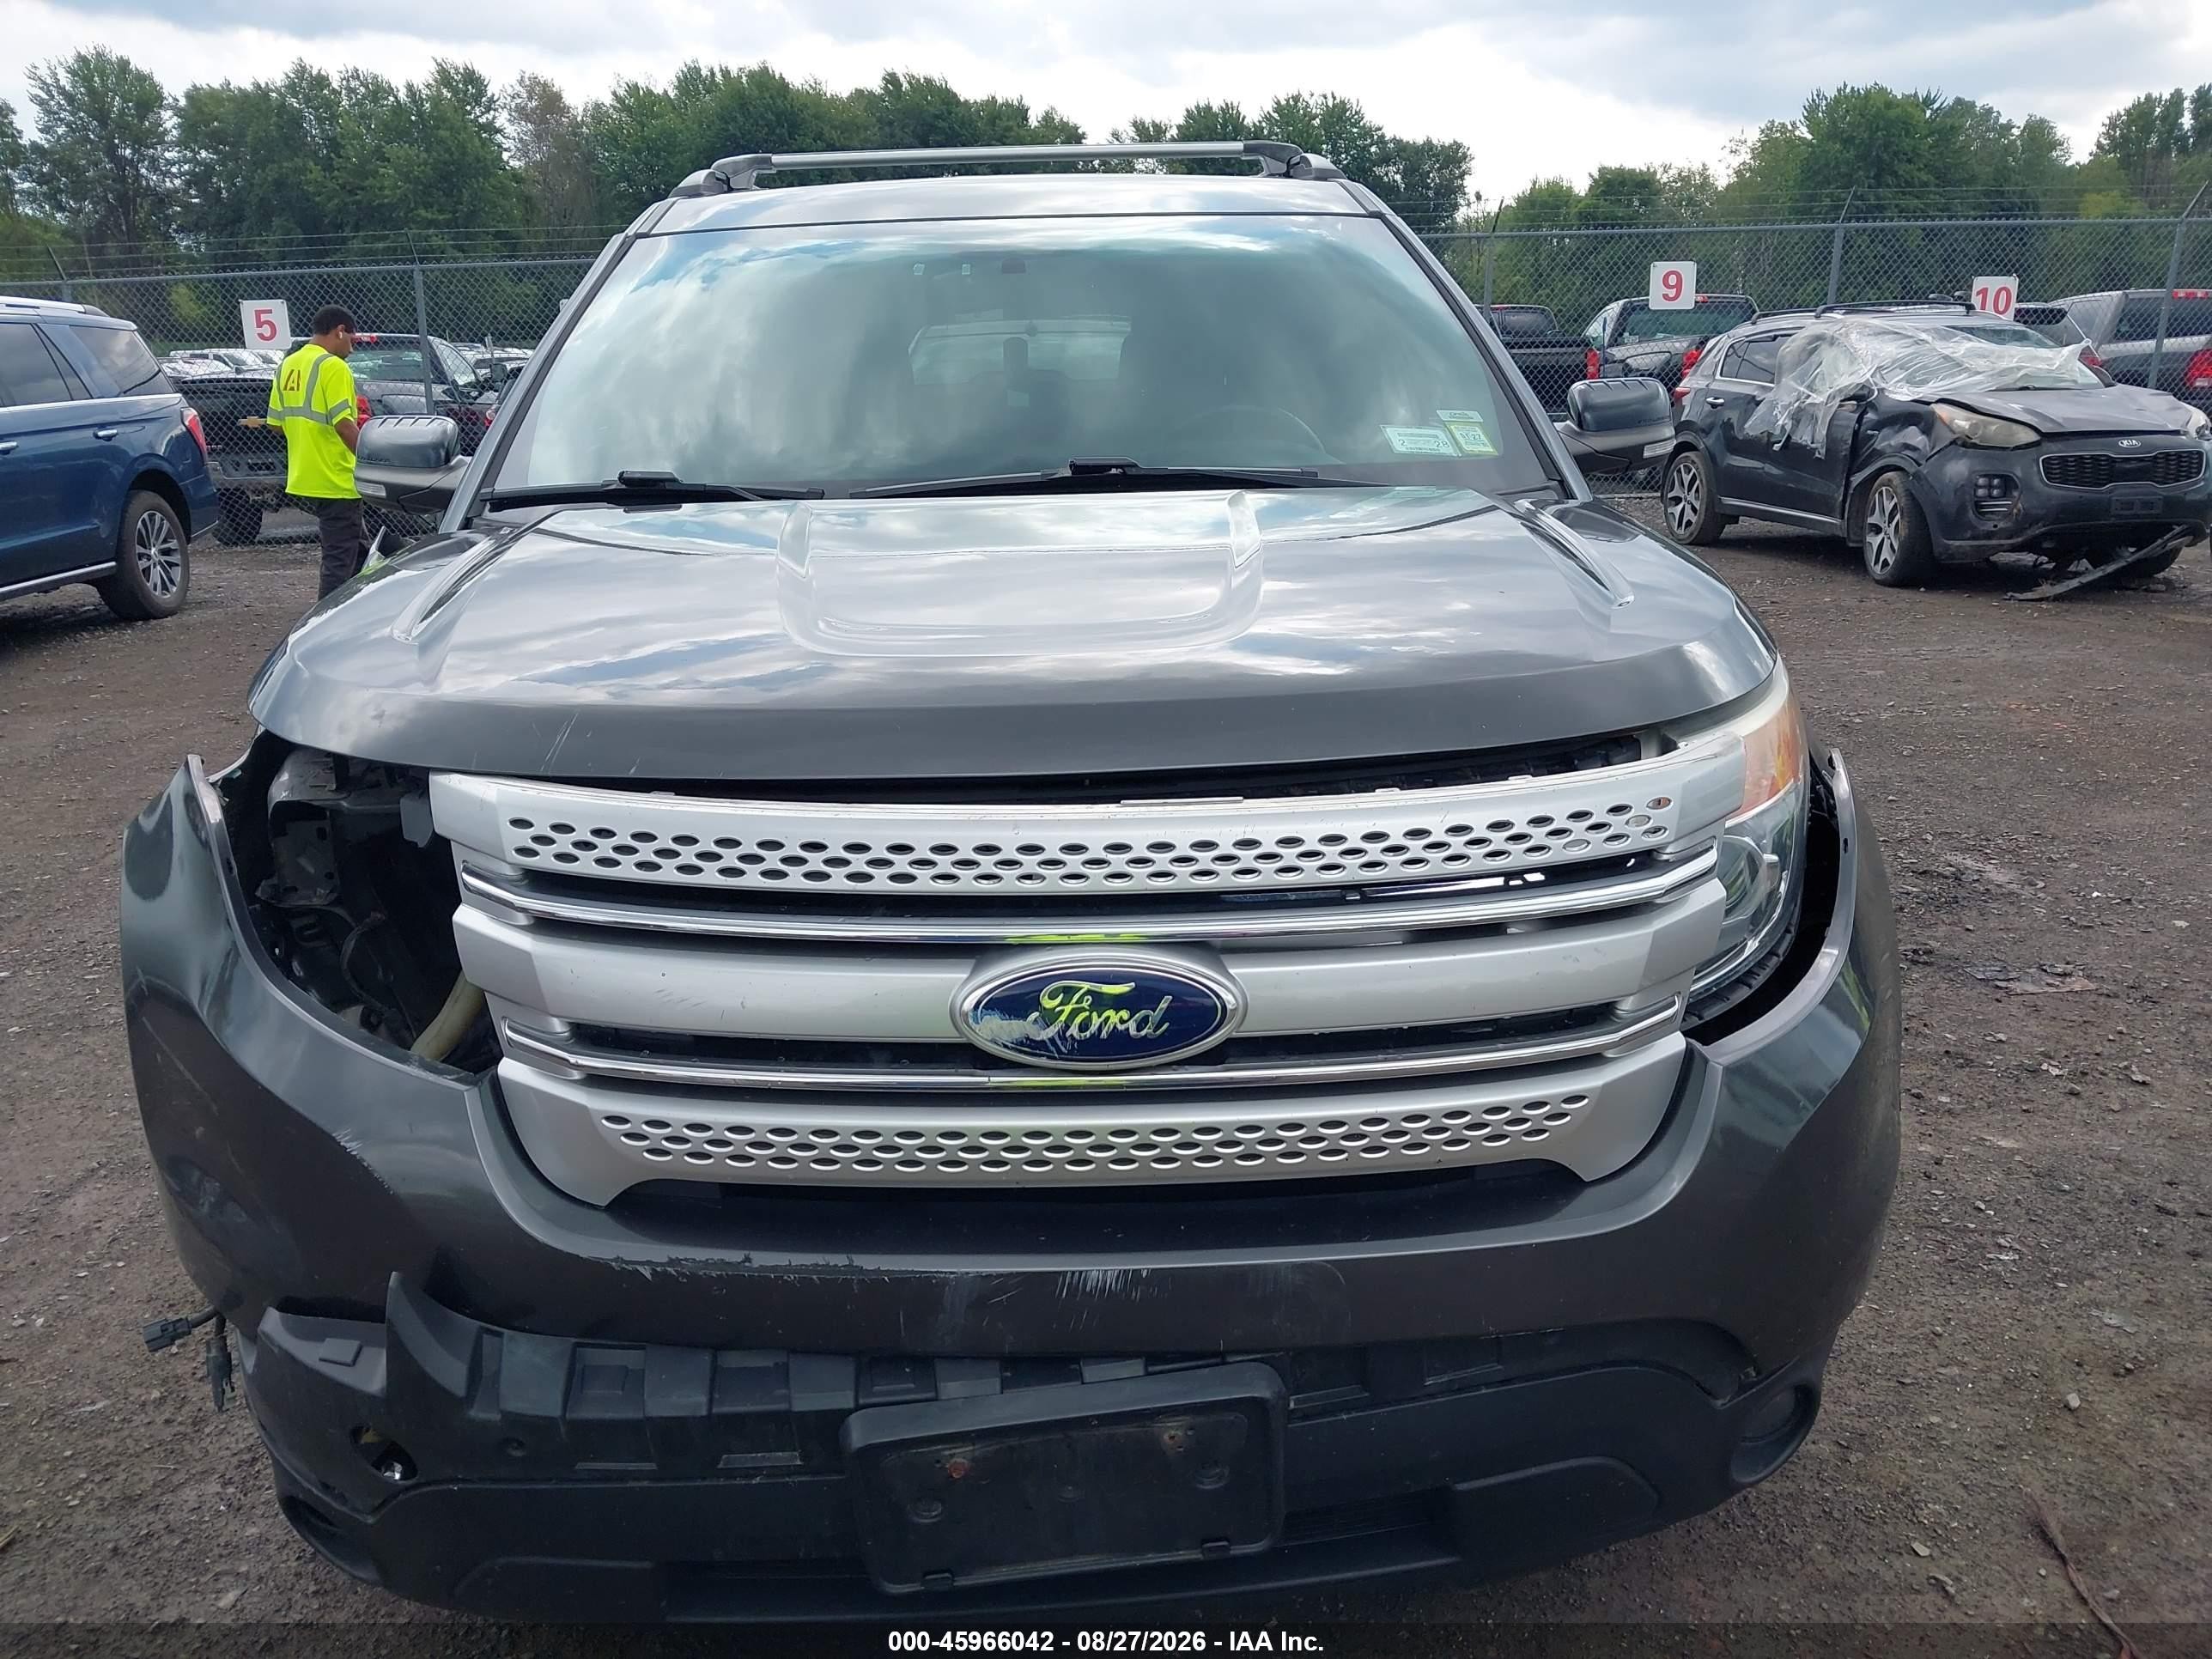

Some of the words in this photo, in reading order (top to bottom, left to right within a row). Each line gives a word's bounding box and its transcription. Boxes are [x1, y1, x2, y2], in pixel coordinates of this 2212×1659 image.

[1662, 270, 1683, 302] 9
[1975, 286, 2013, 315] 10
[253, 308, 277, 342] 5
[1027, 980, 1173, 1041] Ford
